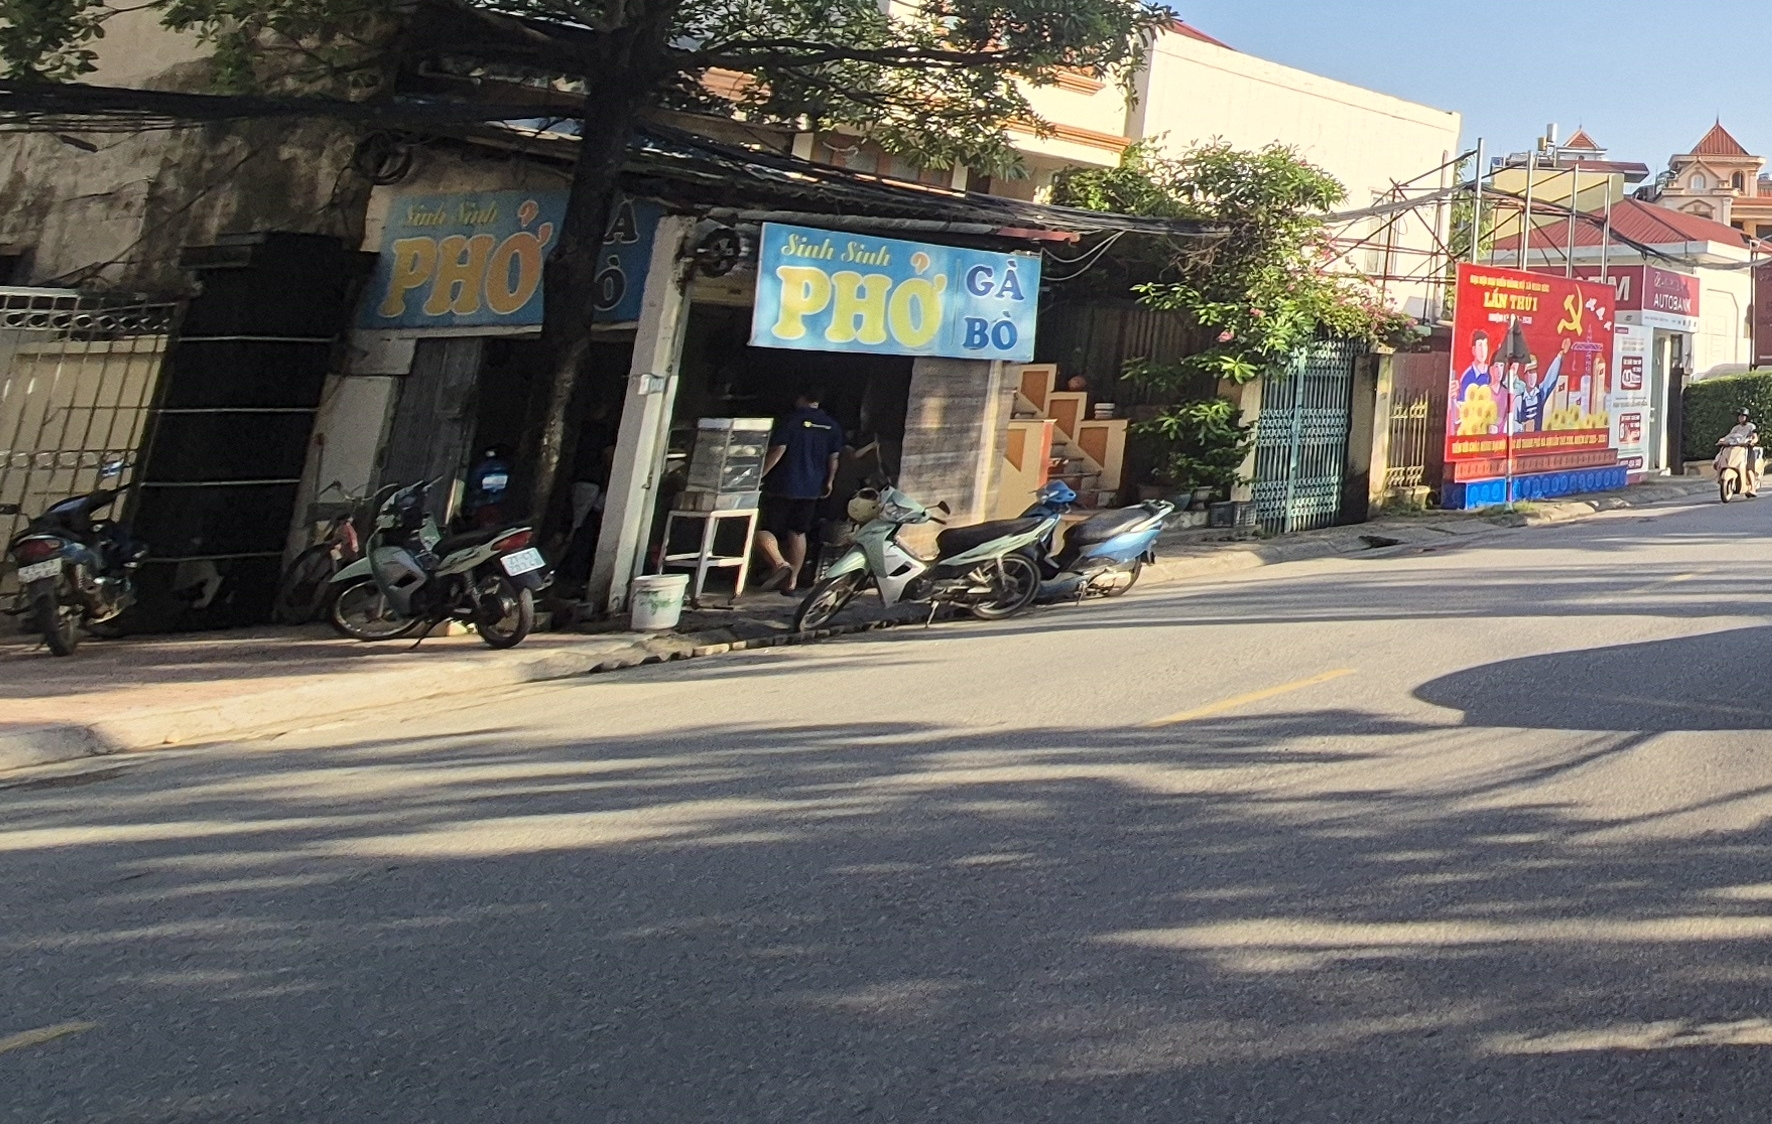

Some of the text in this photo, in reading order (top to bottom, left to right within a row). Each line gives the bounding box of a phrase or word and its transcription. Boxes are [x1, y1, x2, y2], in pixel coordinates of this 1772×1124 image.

[379, 199, 553, 318] PHỞ
[781, 233, 891, 267] Sinh Sinh
[771, 251, 947, 348] PHỞ
[966, 260, 1025, 301] GÀ
[962, 311, 1018, 350] BÒ
